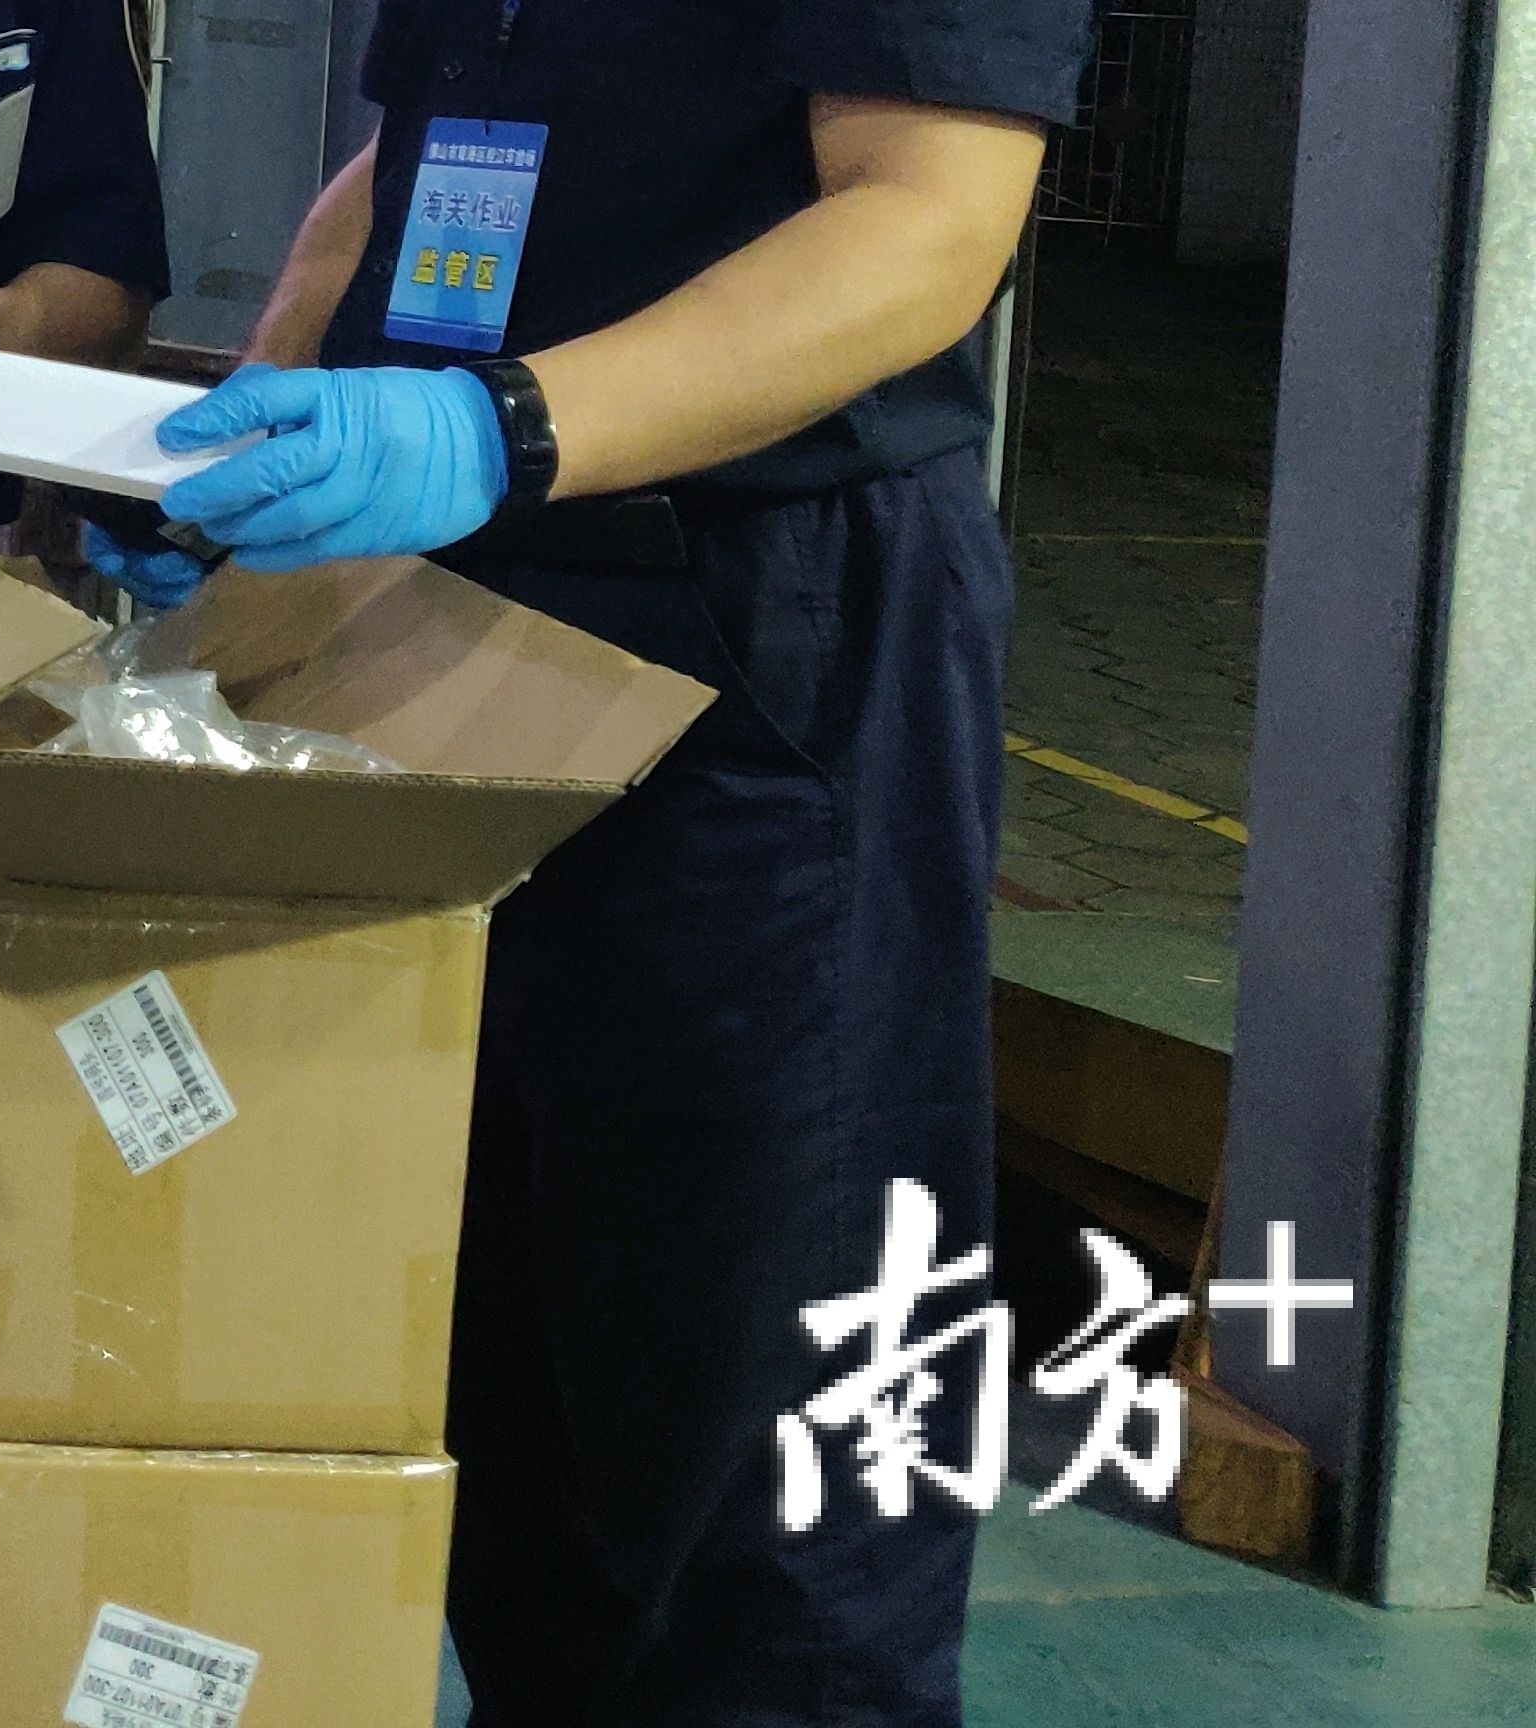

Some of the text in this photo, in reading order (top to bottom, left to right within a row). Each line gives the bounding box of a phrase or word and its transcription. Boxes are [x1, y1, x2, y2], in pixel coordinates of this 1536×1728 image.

[420, 188, 521, 232] 海关作业
[411, 247, 500, 291] 监管区
